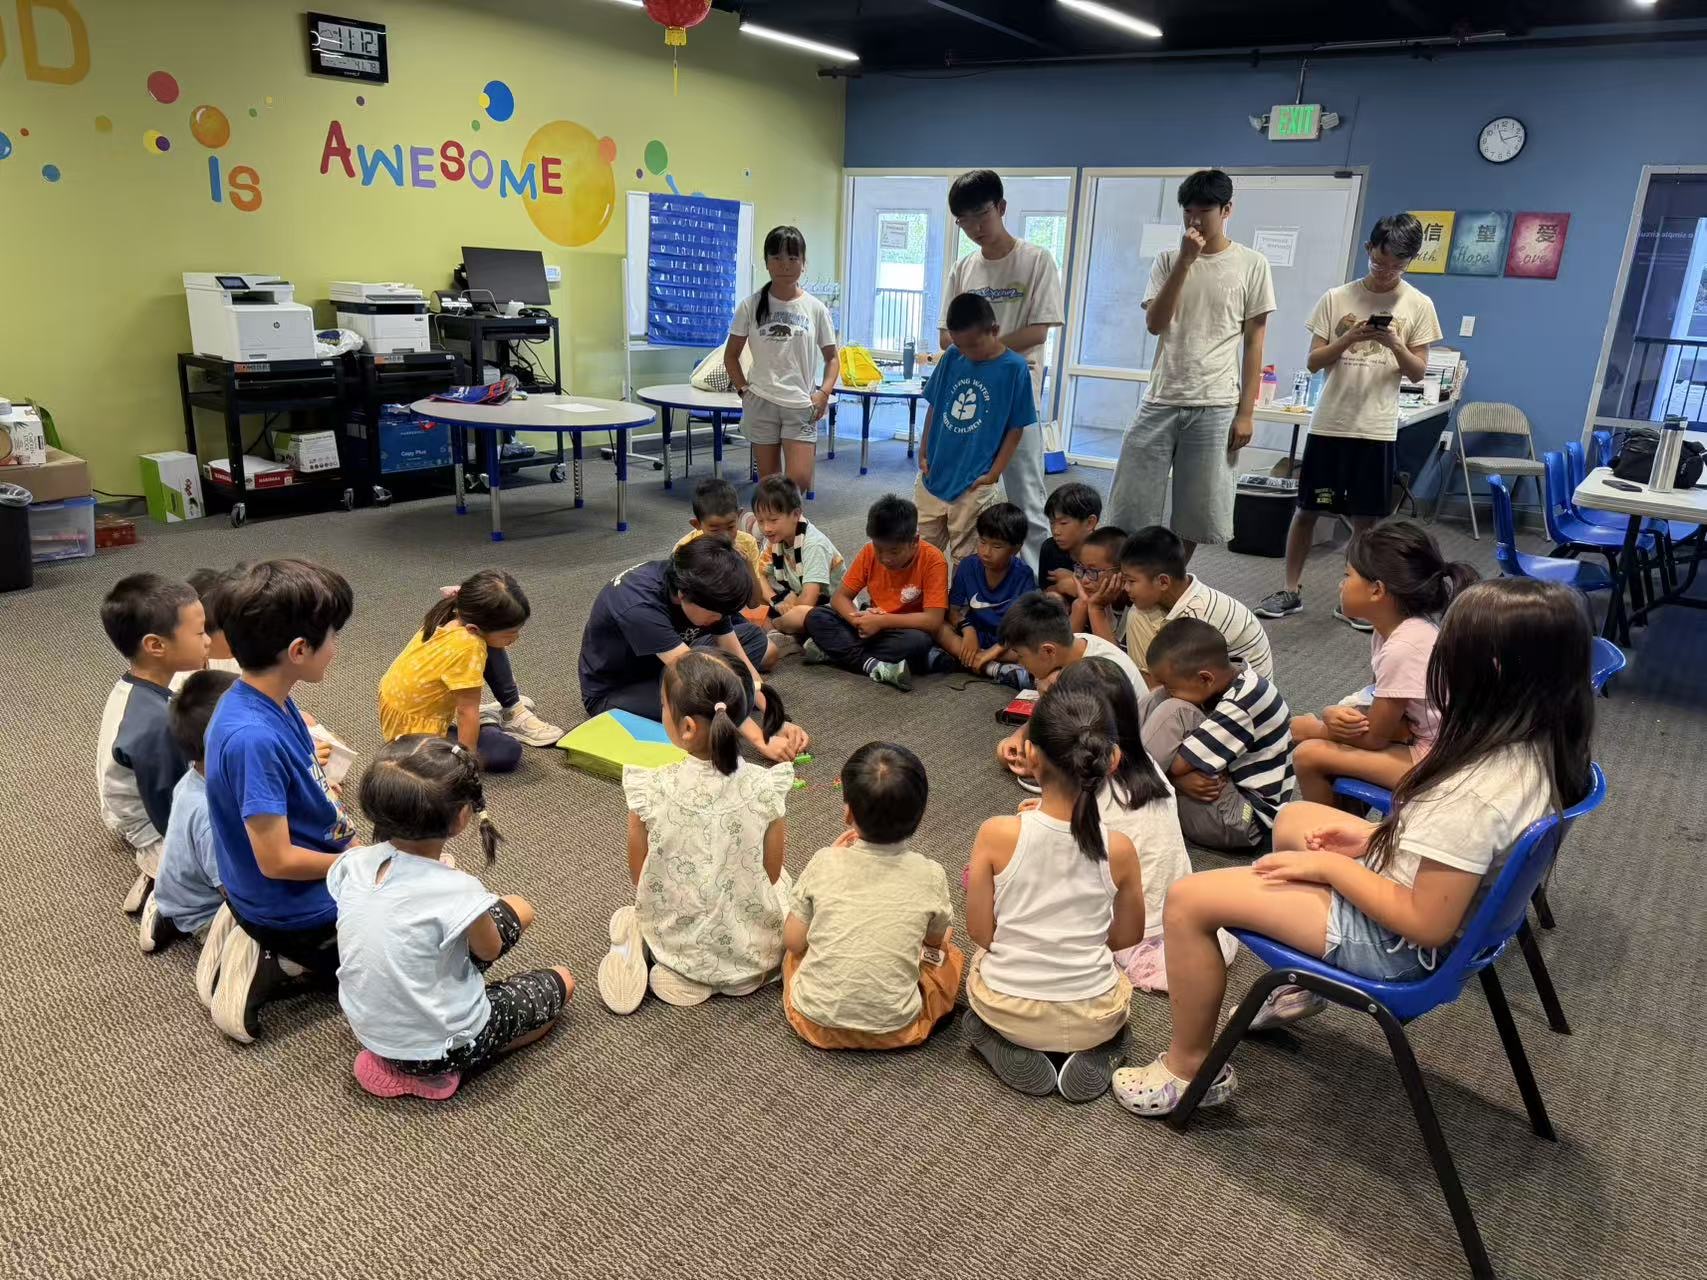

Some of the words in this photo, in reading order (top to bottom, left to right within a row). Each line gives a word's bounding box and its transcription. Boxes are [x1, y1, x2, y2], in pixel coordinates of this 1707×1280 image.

[1280, 106, 1314, 136] EXIT
[208, 155, 263, 213] IS
[320, 120, 563, 201] AWESOME
[1424, 223, 1444, 242] 信
[1476, 224, 1497, 243] 望
[1456, 246, 1490, 265] Hope
[950, 377, 971, 395] LIVING
[972, 379, 991, 402] WATER
[953, 418, 983, 433] CHURCH
